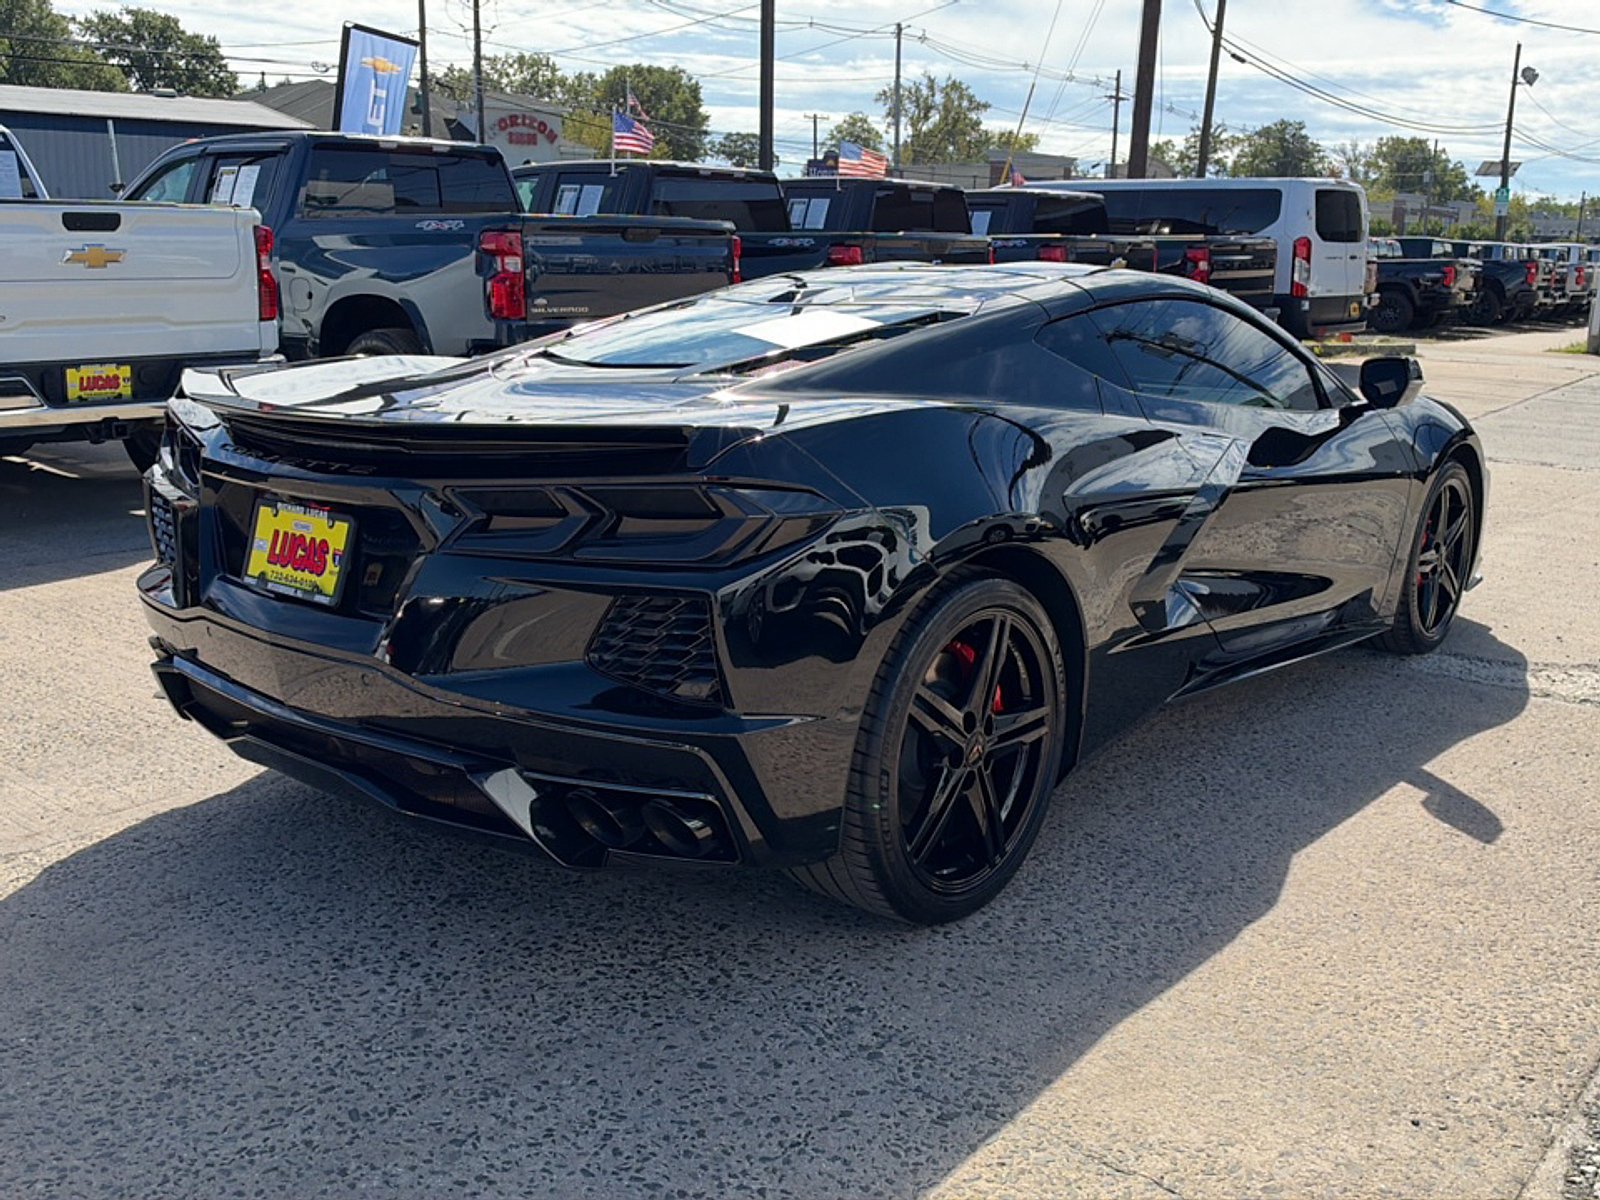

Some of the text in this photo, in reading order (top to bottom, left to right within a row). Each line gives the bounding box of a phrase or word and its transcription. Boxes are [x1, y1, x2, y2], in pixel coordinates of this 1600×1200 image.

[530, 305, 590, 314] SILVERADO
[79, 374, 120, 392] LUCAS
[267, 529, 330, 577] LUCAS
